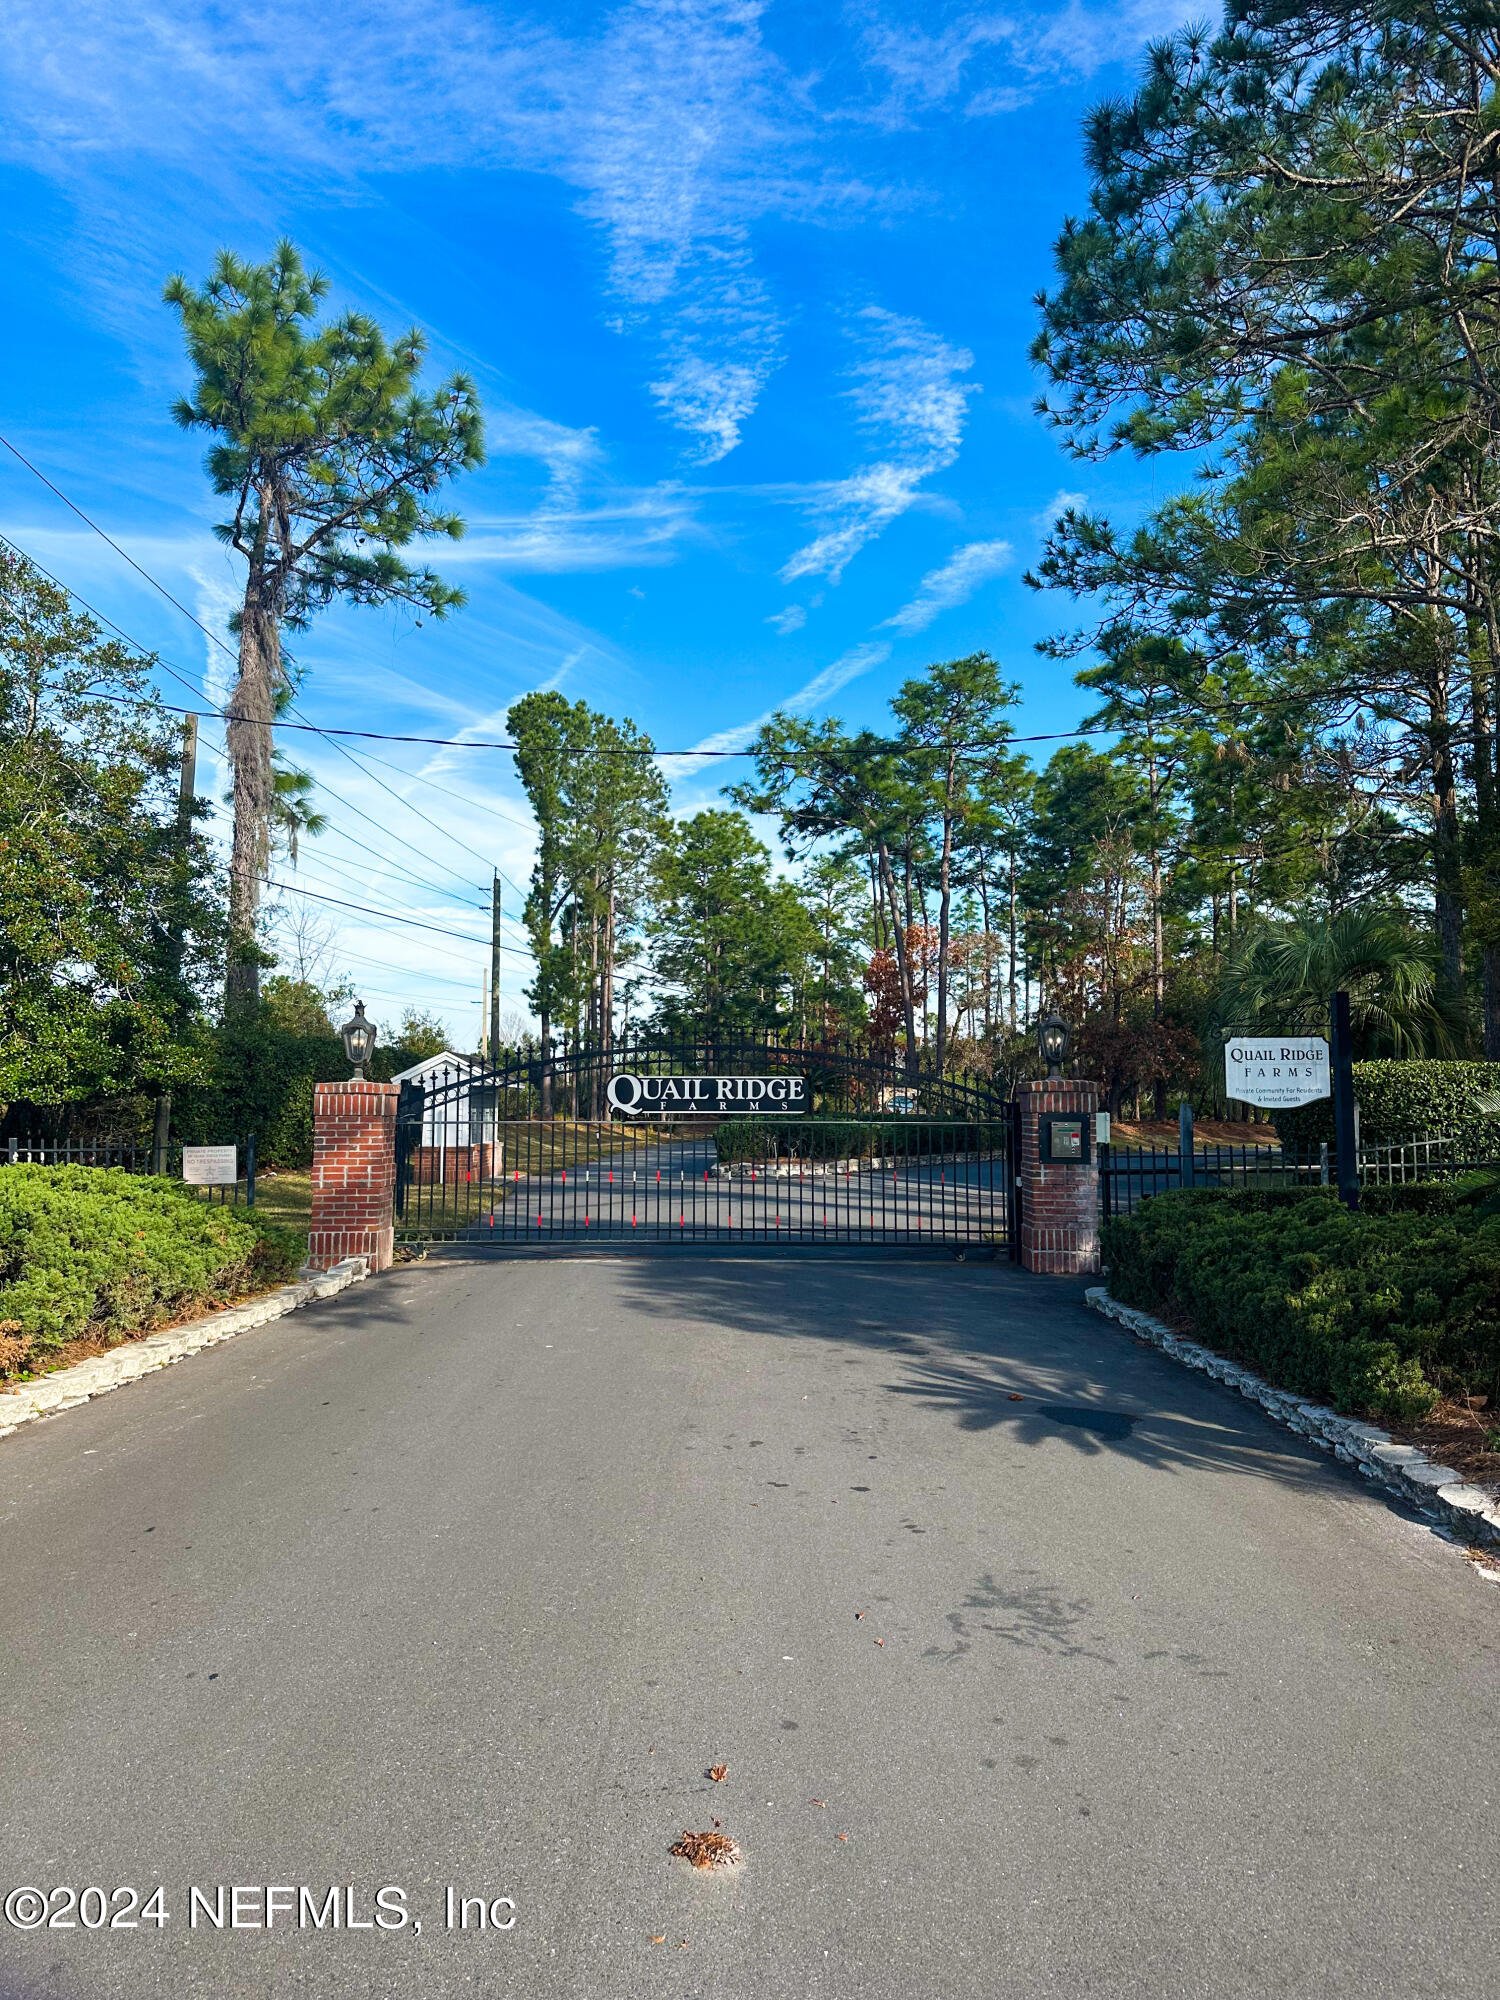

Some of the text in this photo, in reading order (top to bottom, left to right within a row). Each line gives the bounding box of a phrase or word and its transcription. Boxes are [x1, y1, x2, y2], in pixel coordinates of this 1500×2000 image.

[1230, 1048, 1324, 1063] QUAIL RIDGE
[1245, 1067, 1313, 1078] FARMS
[606, 1073, 805, 1116] QUAIL RIDGE
[1255, 1087, 1285, 1095] Community
[660, 1101, 788, 1111] FARMS
